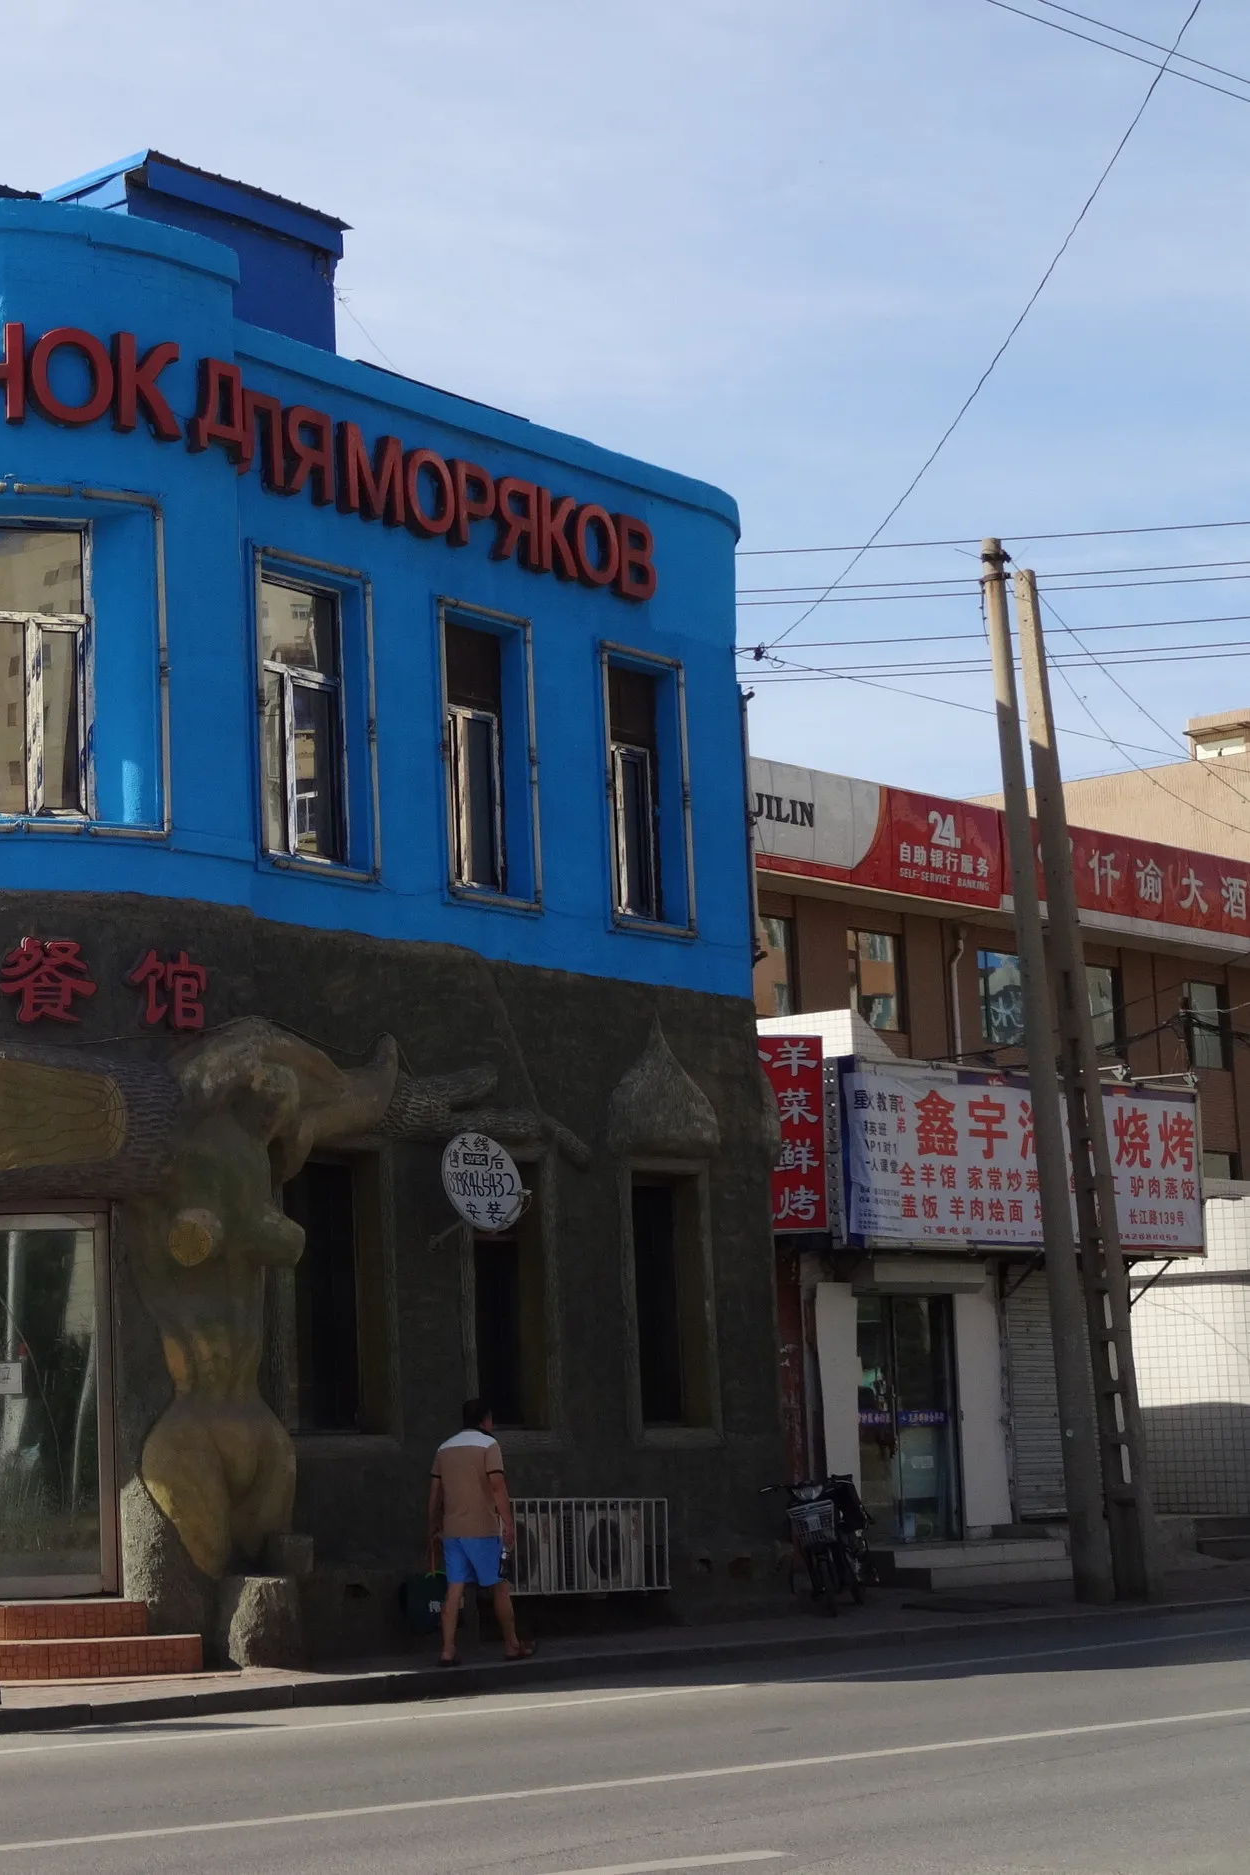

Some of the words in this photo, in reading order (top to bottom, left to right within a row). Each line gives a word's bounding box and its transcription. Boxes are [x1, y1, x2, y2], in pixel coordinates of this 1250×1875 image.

[188, 358, 336, 506] ДЛЯ
[337, 420, 657, 603] МОРЯКОВ
[753, 792, 815, 828] JILIN
[899, 842, 990, 878] 自助银行服务
[957, 878, 990, 891] BANKING
[458, 1136, 490, 1152] 天线
[899, 1162, 957, 1189] 全羊馆
[967, 1166, 1040, 1193] 家常炒菜
[466, 1201, 506, 1223] 安装
[901, 1193, 939, 1219] 盖饭
[949, 1196, 1023, 1223] 羊肉烩面
